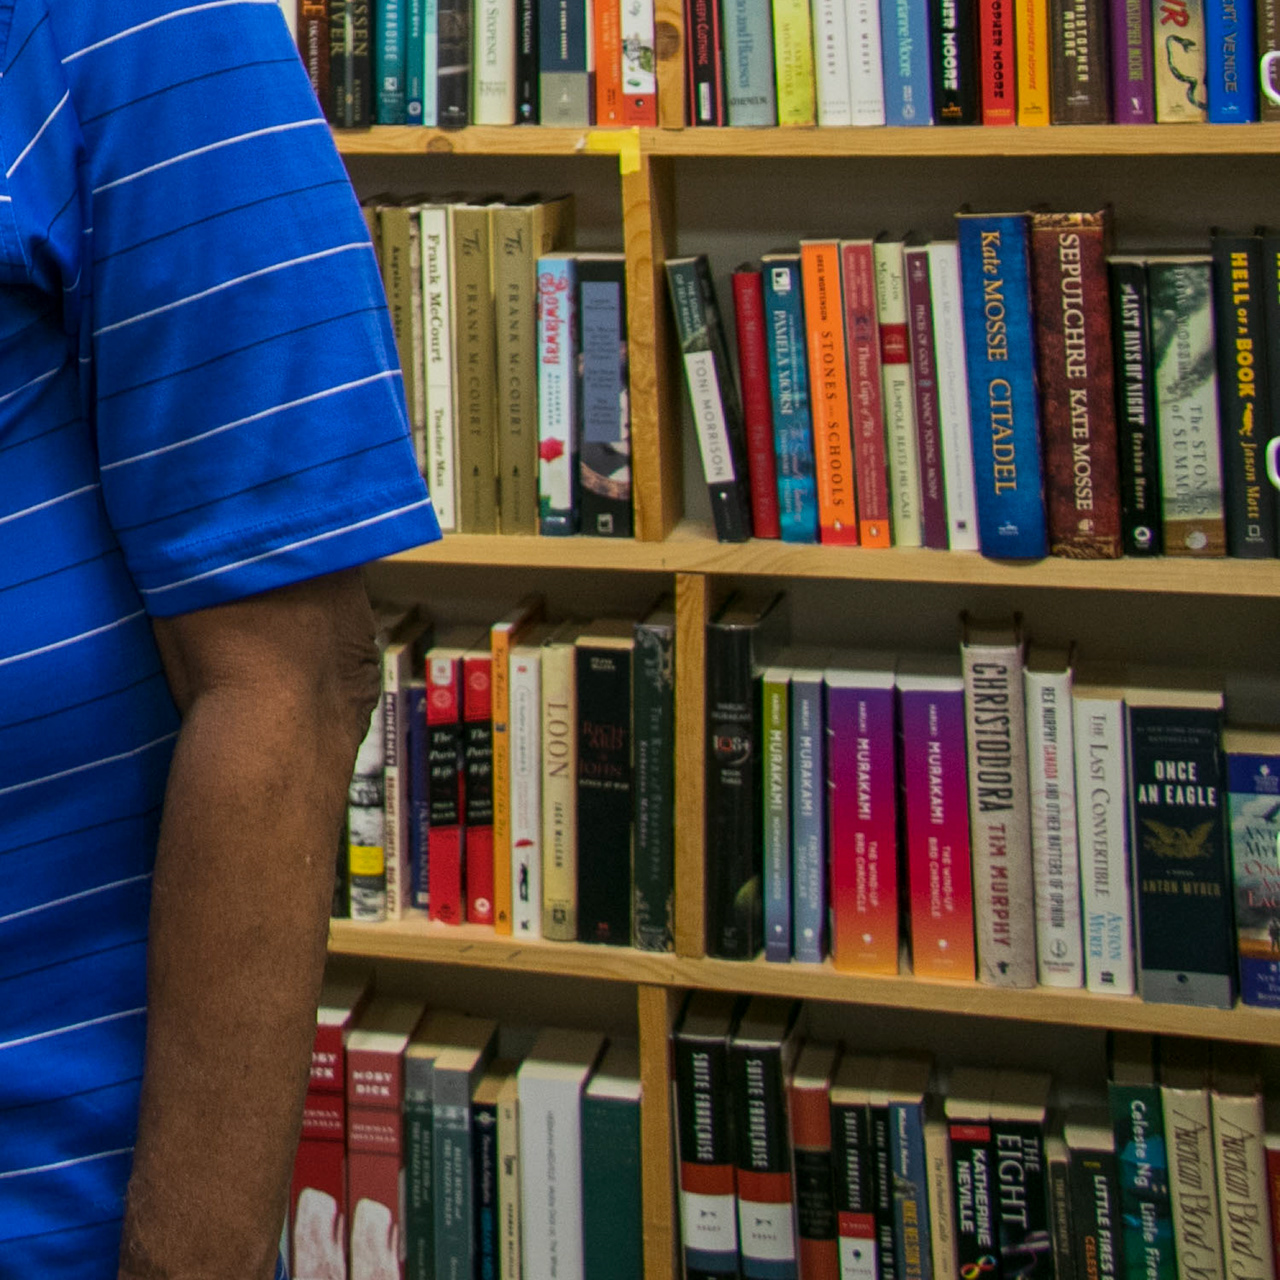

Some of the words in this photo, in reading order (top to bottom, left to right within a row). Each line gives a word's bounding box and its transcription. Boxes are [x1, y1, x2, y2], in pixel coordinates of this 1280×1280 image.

[942, 31, 956, 90] MOORE
[991, 48, 1003, 99] MOORE
[427, 234, 439, 286] Frank
[981, 230, 999, 273] Kate
[1231, 251, 1249, 304] HELL
[430, 293, 441, 364] McCourt
[984, 278, 1008, 362] MOSSE
[1059, 233, 1087, 379] SEPULCHRE
[822, 331, 835, 400] STONES
[1236, 338, 1254, 398] BOOK
[695, 358, 708, 391] TONI
[703, 398, 723, 476] MORRISON
[988, 378, 1017, 494] CITADEL
[1069, 389, 1088, 439] KATE
[828, 422, 845, 508] SCHOOLS
[1071, 441, 1092, 511] MOSSE
[548, 702, 569, 779] LOON
[972, 663, 1014, 813] CHRISTODORA
[1091, 714, 1107, 739] THE
[858, 739, 870, 819] MURAKAMI
[928, 741, 943, 825] MURAKAMI
[1091, 743, 1108, 781] LAST
[1154, 760, 1197, 781] ONCE
[1140, 785, 1160, 804] AN
[1167, 785, 1217, 807] EAGLE
[988, 823, 1007, 856] TIM
[1091, 788, 1111, 897] CONVERTIBLE
[989, 865, 1011, 949] MURPHY
[353, 1071, 392, 1082] MOBY
[356, 1084, 390, 1095] DICK
[1023, 1138, 1039, 1172] THE
[1131, 1099, 1145, 1162] Celeste
[956, 1161, 974, 1233] NEVILLE
[973, 1148, 991, 1247] KATHERINE
[996, 1134, 1026, 1228] EIGHT
[1134, 1164, 1151, 1187] Ng
